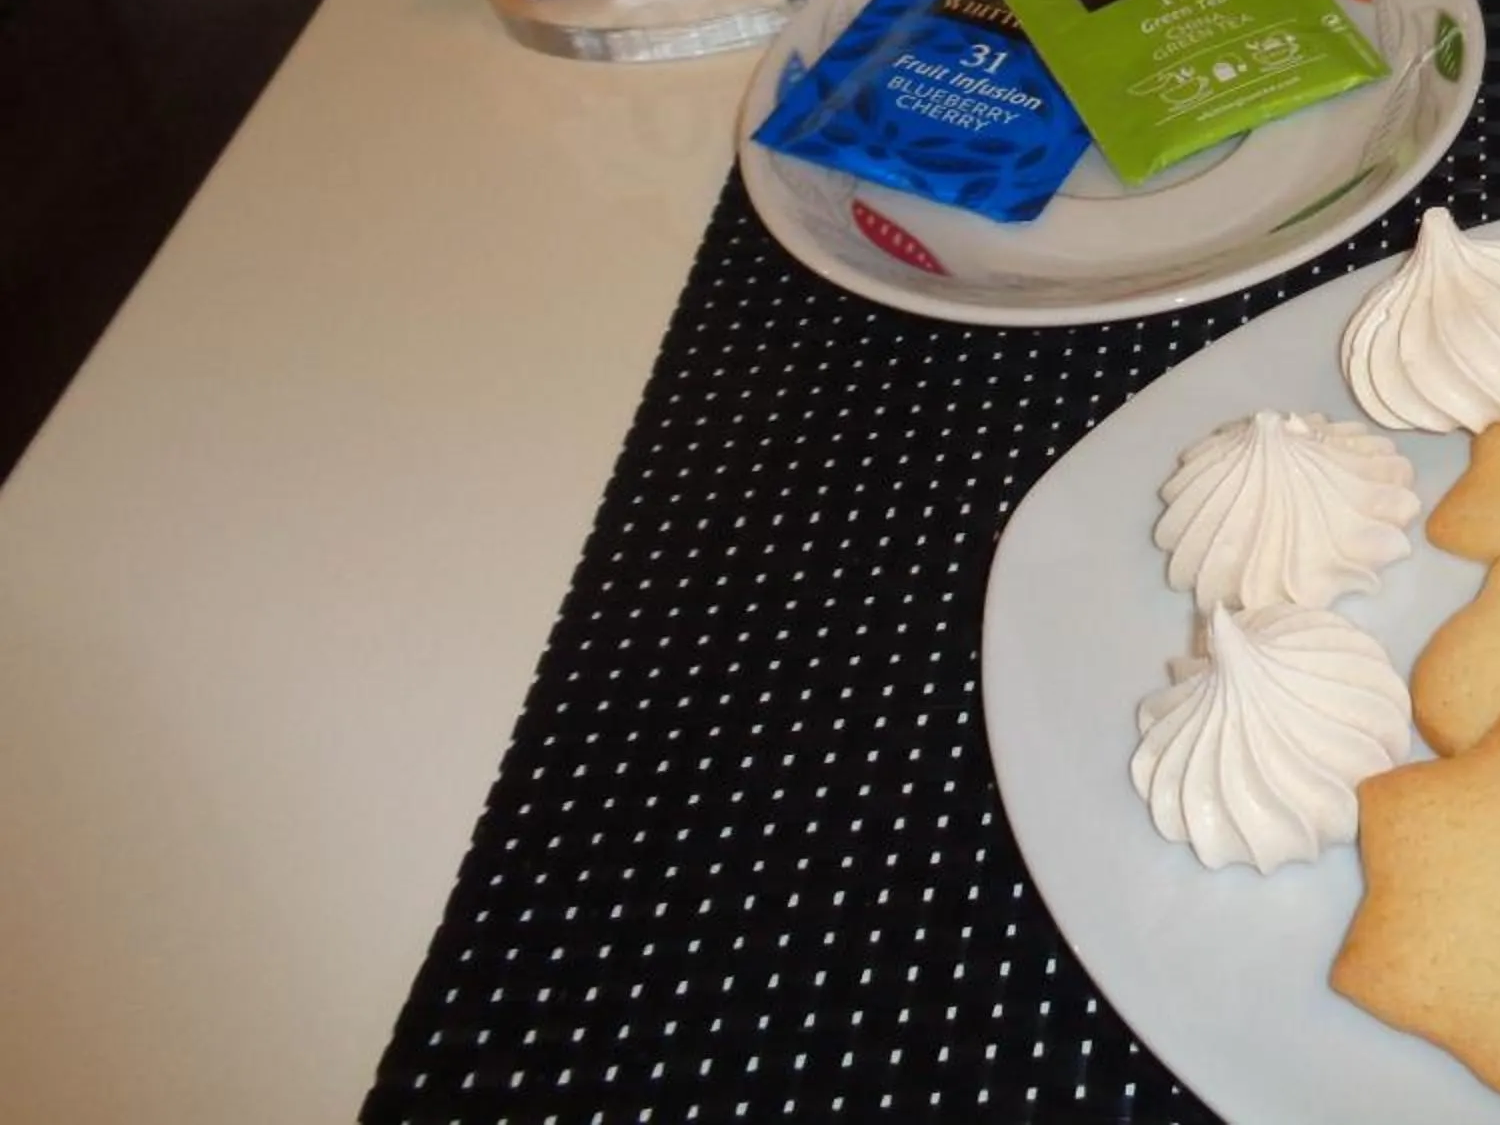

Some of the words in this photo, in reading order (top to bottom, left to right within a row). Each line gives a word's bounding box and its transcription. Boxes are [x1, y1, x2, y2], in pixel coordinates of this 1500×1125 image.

[1140, 6, 1193, 34] Green
[892, 53, 950, 80] Fruit
[959, 43, 1009, 75] 31
[886, 75, 1021, 124] BLUEBERRY
[895, 93, 991, 132] CHERRY
